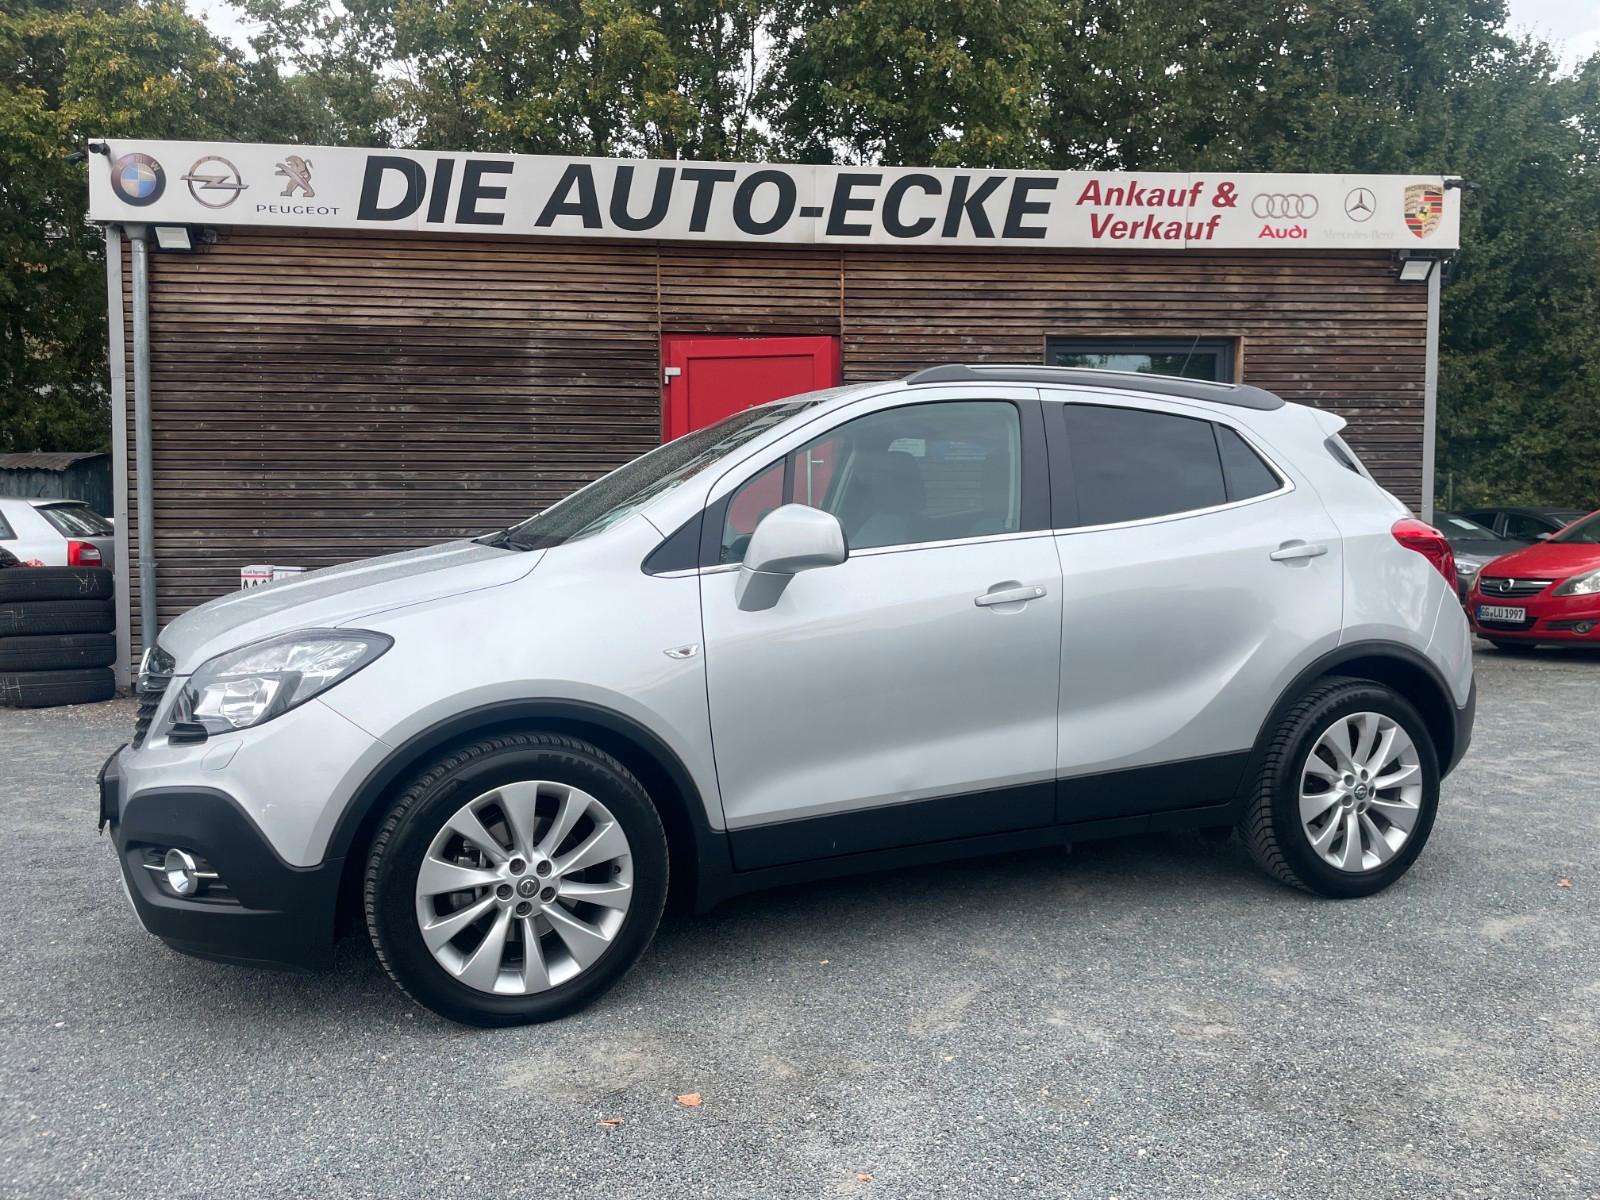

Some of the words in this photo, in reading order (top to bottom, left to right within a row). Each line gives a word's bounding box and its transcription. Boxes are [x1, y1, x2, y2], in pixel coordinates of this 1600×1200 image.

[356, 155, 514, 226] DIE
[534, 163, 1060, 240] AUTO-ECKE
[1076, 179, 1206, 208] Ankauf
[1212, 181, 1239, 208] &
[256, 204, 341, 215] PEUGEOT
[1089, 213, 1222, 241] Verkauf
[1258, 224, 1308, 239] Audi
[1505, 608, 1524, 620] 1997
